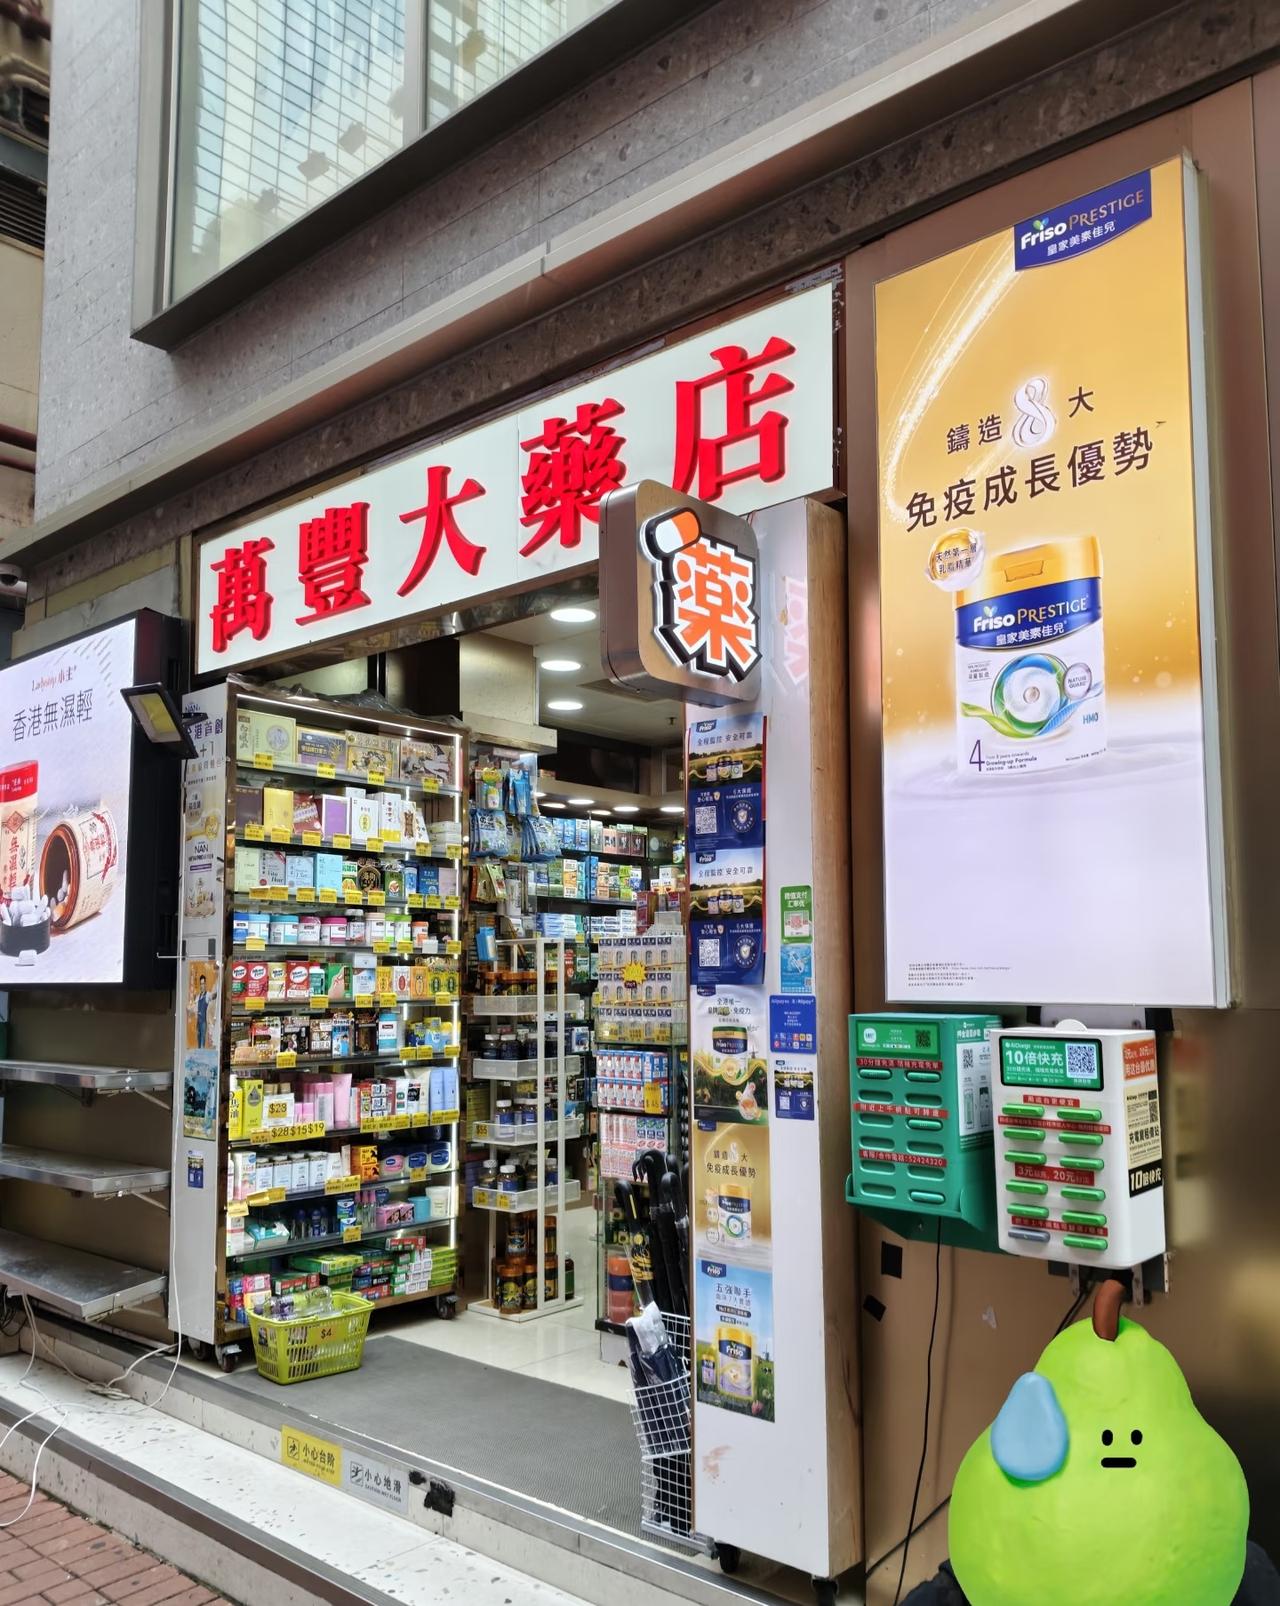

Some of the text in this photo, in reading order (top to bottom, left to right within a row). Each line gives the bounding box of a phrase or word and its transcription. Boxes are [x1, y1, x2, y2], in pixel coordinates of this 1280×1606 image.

[1020, 189, 1145, 250] Friso PRESTIGE
[1047, 220, 1115, 257] 皇家美素佳兒
[210, 335, 797, 653] 萬豐大藥店
[905, 426, 1153, 533] 免疫成長優勢
[973, 598, 1087, 633] Friso PRESTIGE
[996, 622, 1065, 646] 皇家美素佳兒
[13, 688, 93, 742] 香港無濕輕
[969, 739, 985, 772] 4
[1005, 1050, 1063, 1066] 10倍快充
[302, 1443, 335, 1468] 小心台阶
[364, 1468, 401, 1495] 小心地滑
